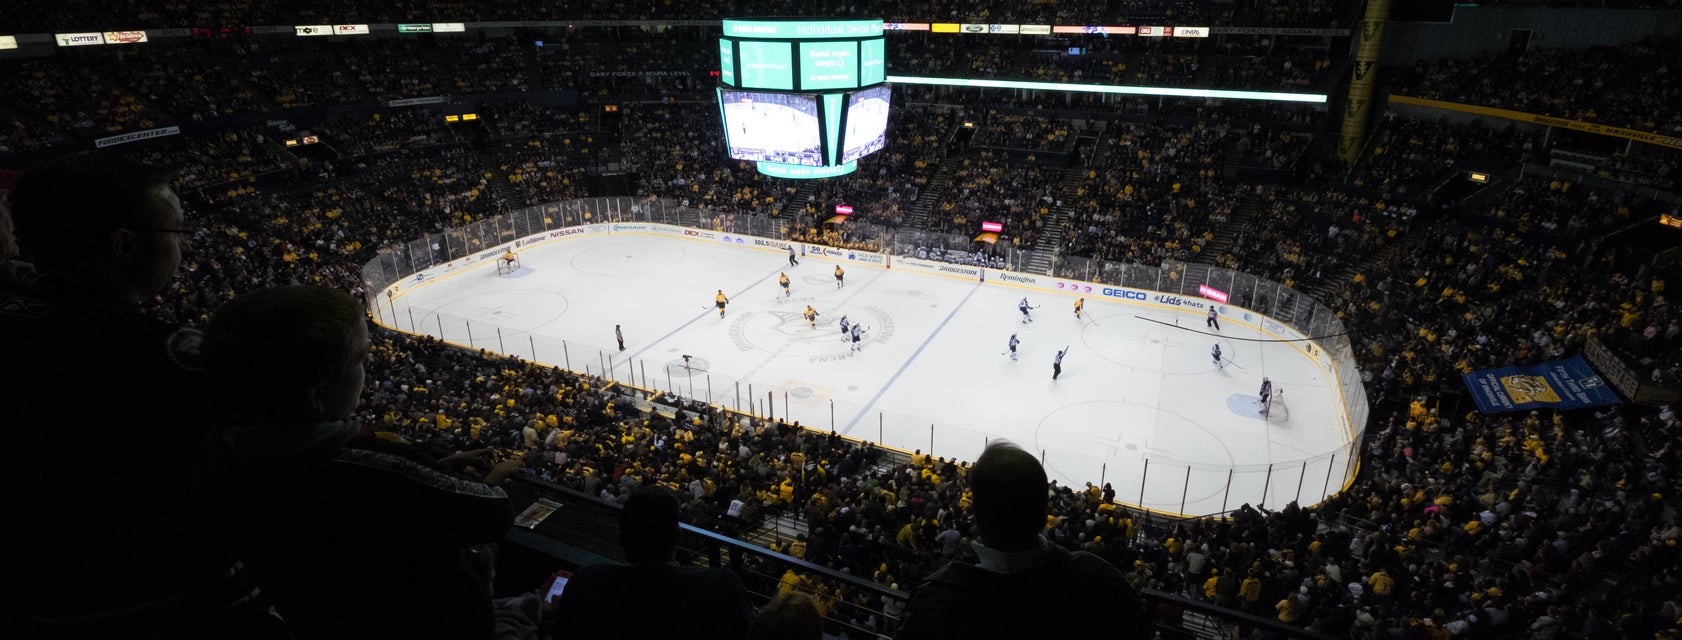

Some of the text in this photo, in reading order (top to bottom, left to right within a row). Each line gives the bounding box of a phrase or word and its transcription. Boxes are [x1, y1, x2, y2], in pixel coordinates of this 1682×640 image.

[797, 25, 844, 34] Individual
[848, 24, 870, 33] Dental
[1605, 127, 1655, 140] NASHVILLE
[550, 228, 584, 238] NISSAN
[939, 265, 976, 276] BRIDGESTONE
[1000, 272, 1036, 284] Remington
[1102, 287, 1147, 301] GEICO
[1200, 286, 1228, 301] NISSAN
